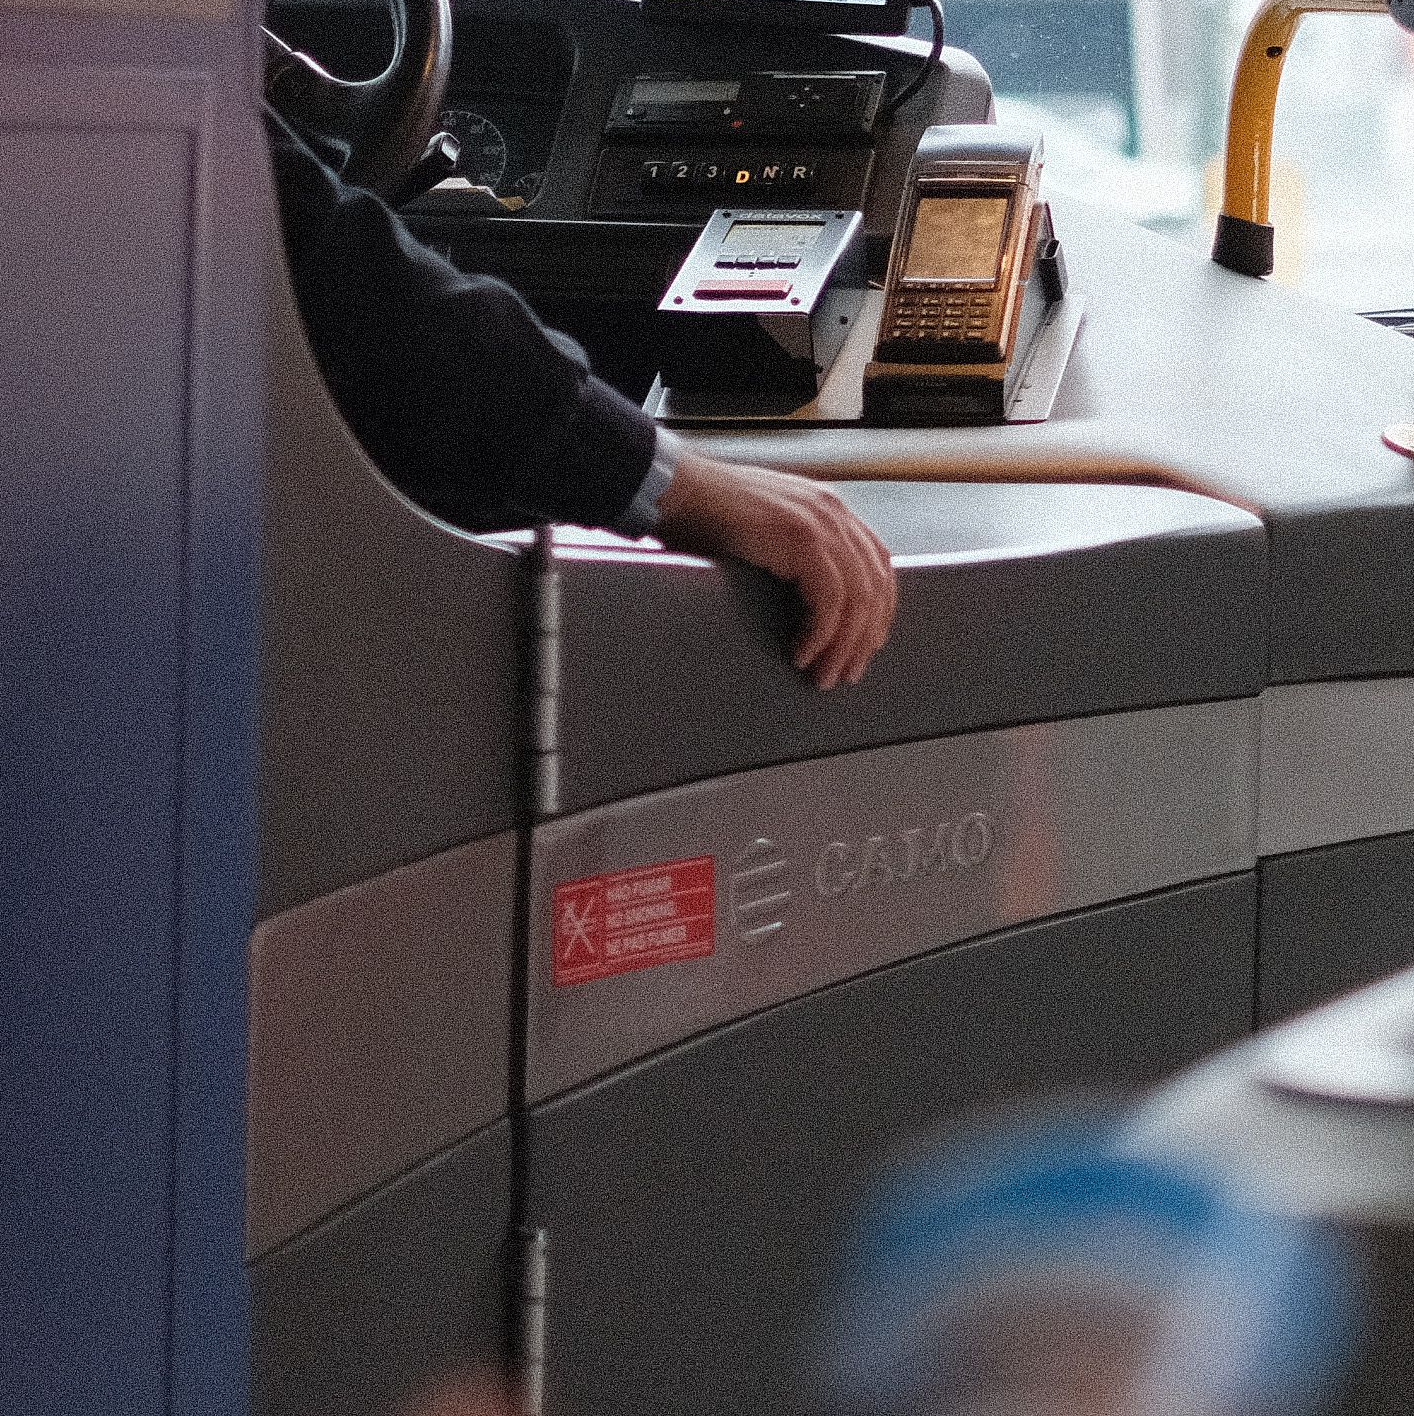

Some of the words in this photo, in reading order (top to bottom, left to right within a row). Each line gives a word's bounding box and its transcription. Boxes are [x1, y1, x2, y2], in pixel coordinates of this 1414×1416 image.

[649, 166, 660, 178] 1
[677, 166, 688, 178] 2
[706, 166, 718, 178] 3
[735, 170, 750, 183] D
[763, 165, 779, 178] N
[792, 166, 806, 178] R
